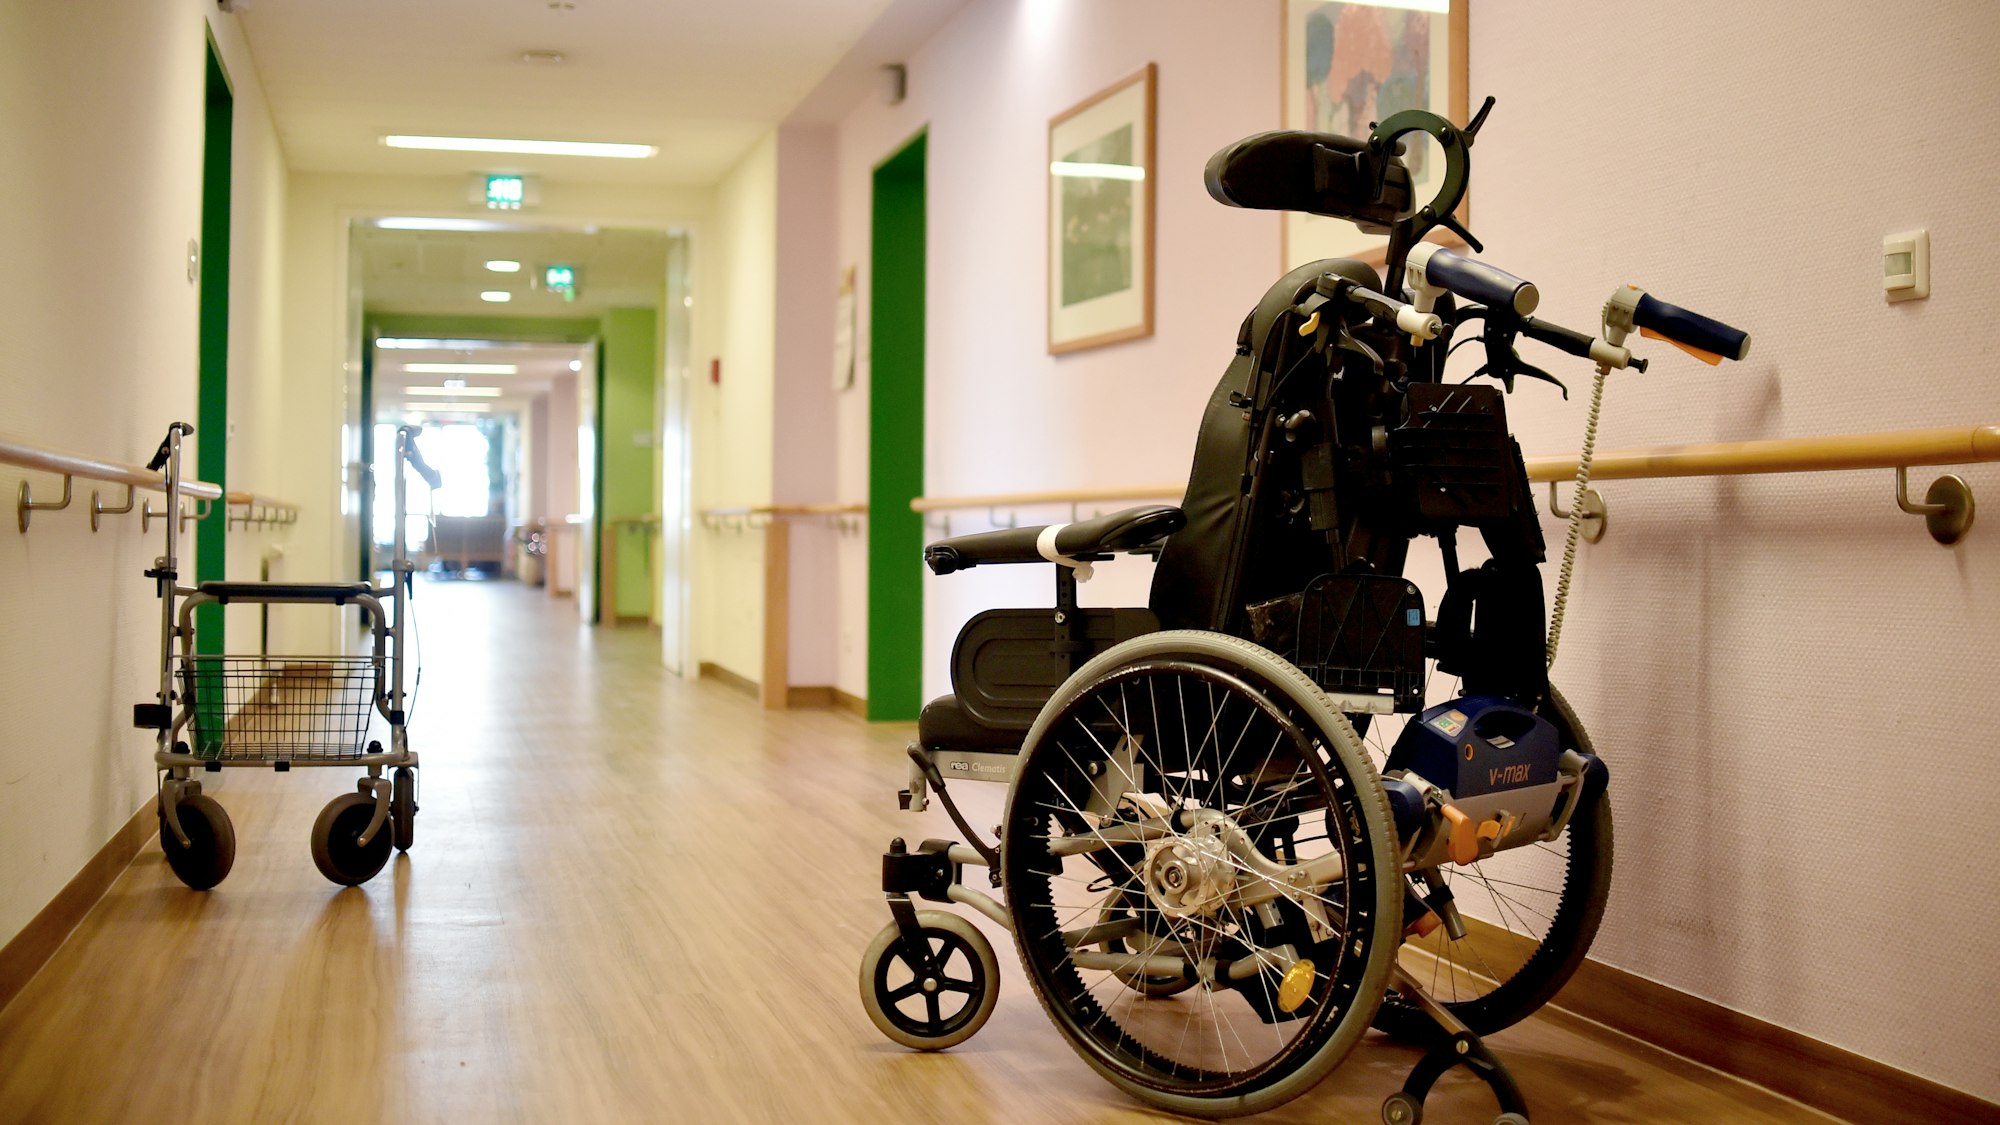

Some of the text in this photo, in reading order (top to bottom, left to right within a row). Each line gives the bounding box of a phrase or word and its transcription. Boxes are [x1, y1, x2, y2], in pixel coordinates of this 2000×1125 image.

[950, 761, 1006, 774] rea Clematis
[1489, 763, 1531, 786] v-max
